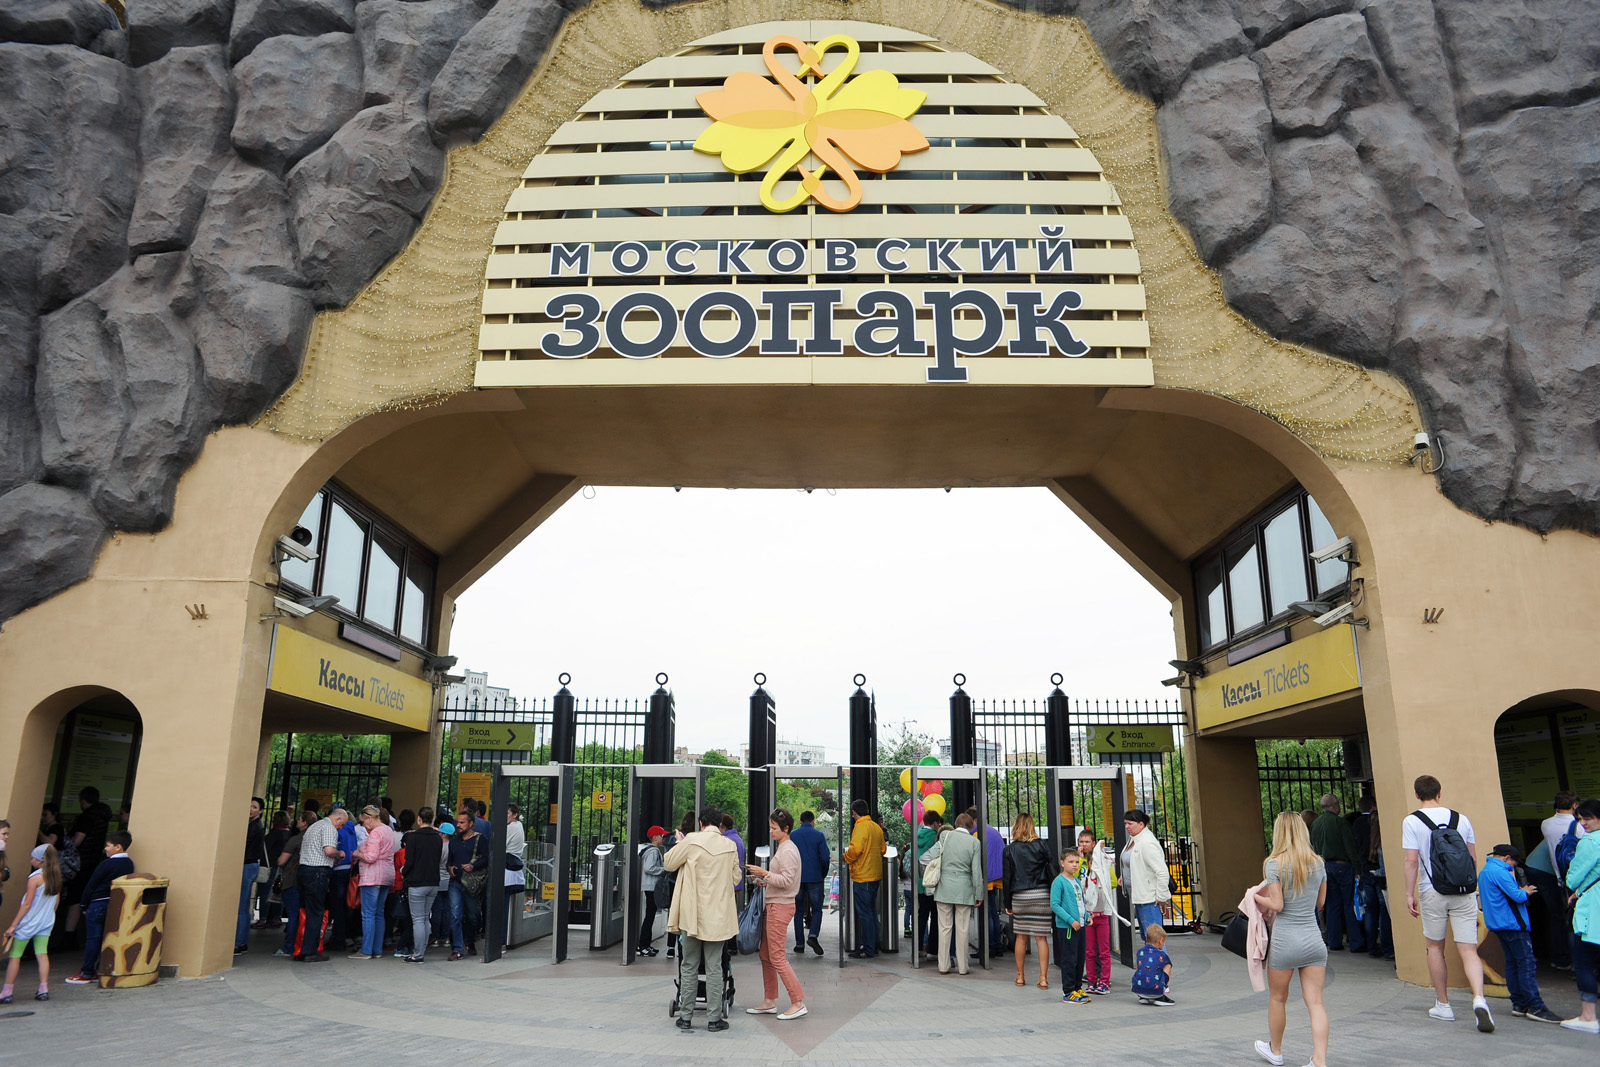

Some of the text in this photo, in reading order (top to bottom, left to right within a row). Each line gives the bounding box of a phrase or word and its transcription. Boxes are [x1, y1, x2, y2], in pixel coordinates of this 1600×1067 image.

[549, 225, 1074, 277] МОСКОВСКИЙ
[318, 657, 406, 712] Кассы Tickets
[1222, 660, 1310, 709] Кассы Tickets
[468, 727, 490, 737] Вход
[1121, 730, 1144, 740] Вход
[467, 737, 501, 746] Entrance
[1121, 740, 1156, 748] Entrance
